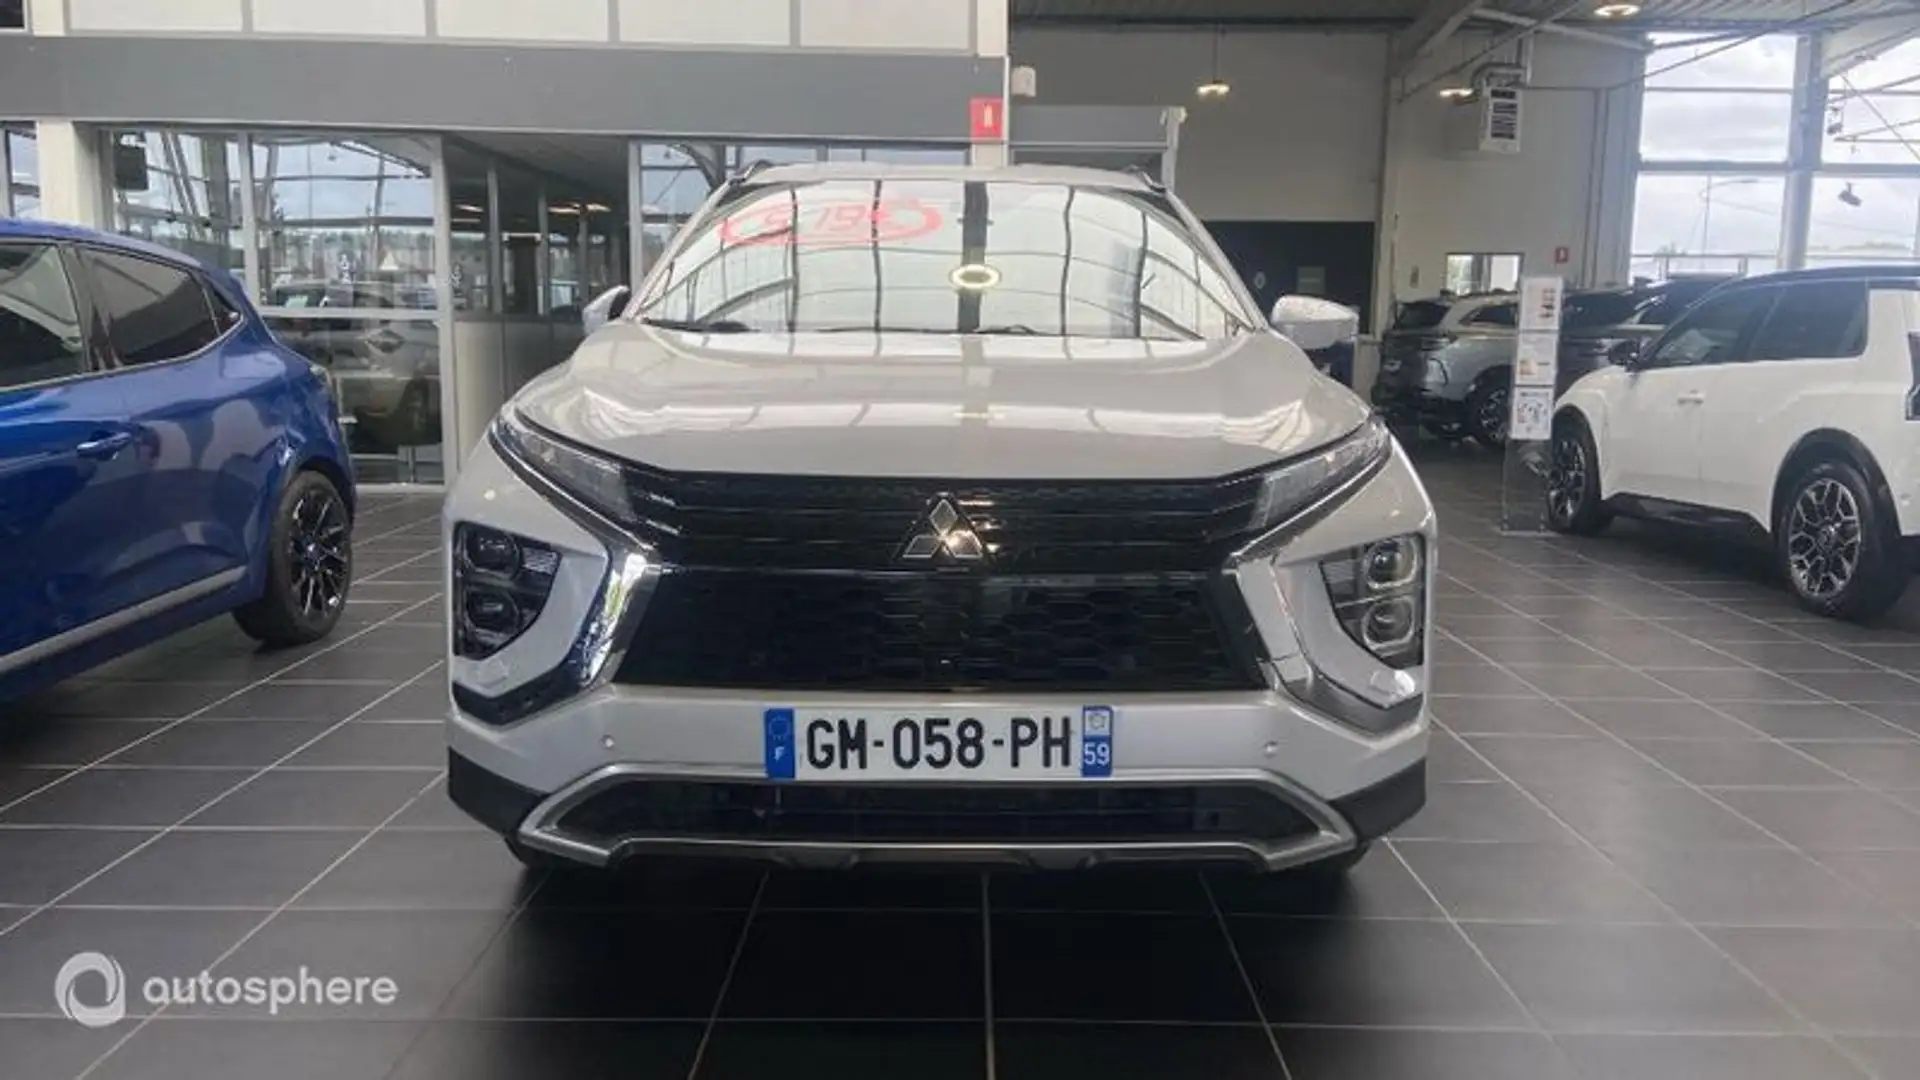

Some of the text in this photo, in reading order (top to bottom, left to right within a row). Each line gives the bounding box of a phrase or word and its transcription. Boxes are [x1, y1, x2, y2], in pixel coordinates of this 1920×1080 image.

[774, 747, 785, 761] F
[806, 717, 1072, 769] GM-058-PH
[1084, 742, 1110, 766] 59
